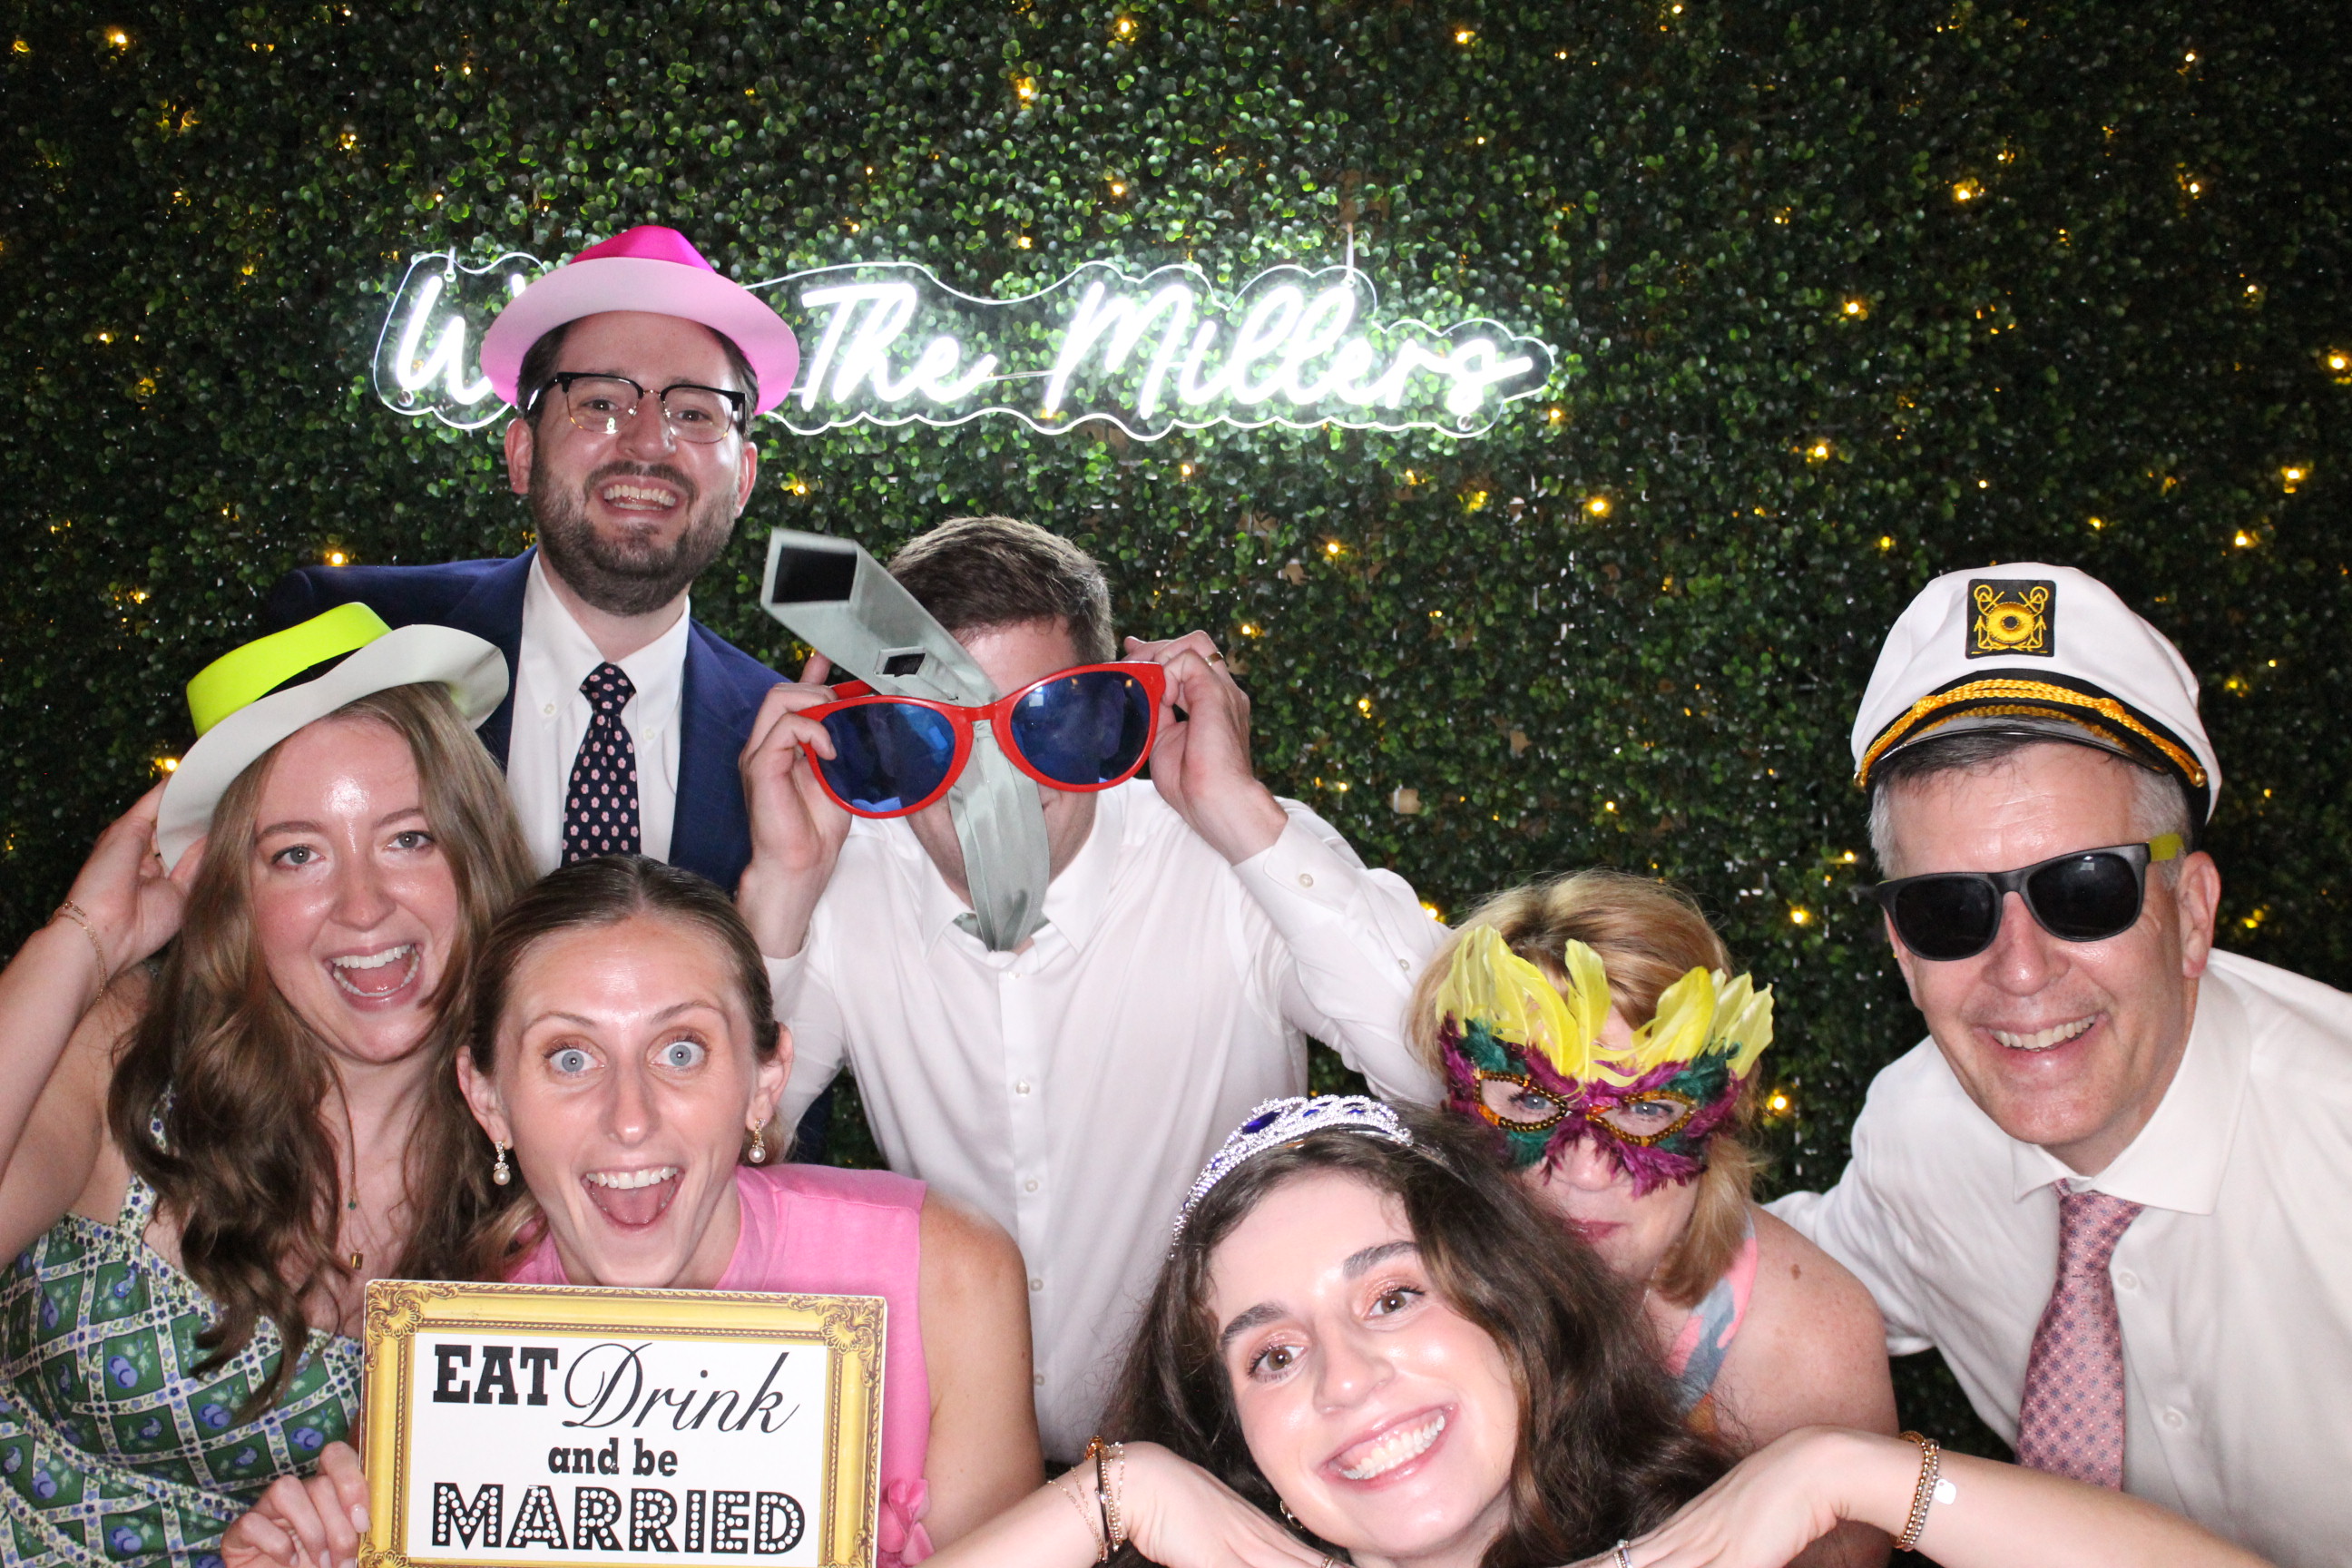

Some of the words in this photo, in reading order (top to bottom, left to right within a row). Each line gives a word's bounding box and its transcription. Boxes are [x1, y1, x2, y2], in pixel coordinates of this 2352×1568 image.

[800, 282, 1000, 412] The
[1042, 281, 1534, 419] Millers
[433, 1343, 559, 1406] EAT
[562, 1342, 800, 1434] Drink
[547, 1437, 620, 1475] and
[632, 1439, 679, 1477] be
[431, 1482, 806, 1555] MARRIED
